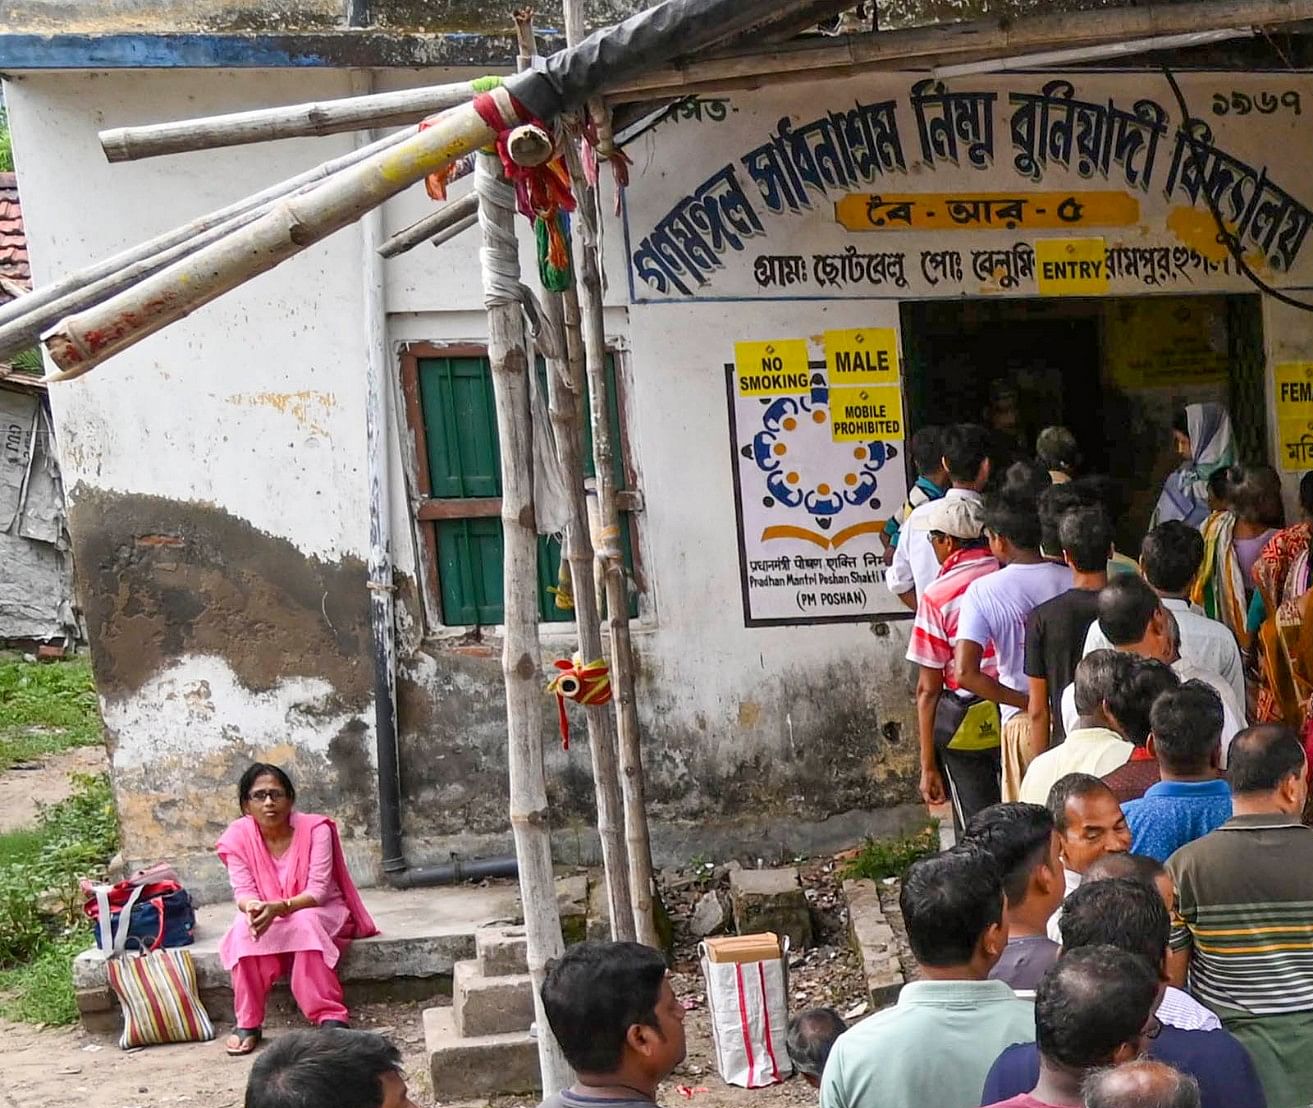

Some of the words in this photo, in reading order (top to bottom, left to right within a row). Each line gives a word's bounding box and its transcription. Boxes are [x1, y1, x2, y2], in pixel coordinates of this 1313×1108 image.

[1213, 91, 1302, 116] ১৯৬৭
[945, 200, 1029, 229] আর
[1042, 260, 1103, 280] ENTRY
[762, 357, 783, 372] NO
[835, 350, 890, 372] MALE
[740, 373, 808, 391] SMOKING
[845, 405, 887, 419] MOBILE
[834, 420, 900, 435] PROHIBITED
[750, 574, 786, 589] Pradhan
[787, 571, 818, 587] Mantri
[819, 571, 850, 587] Poshan
[850, 570, 880, 584] Shakti
[796, 590, 817, 612] (PM
[821, 588, 867, 610] POSHAN)
